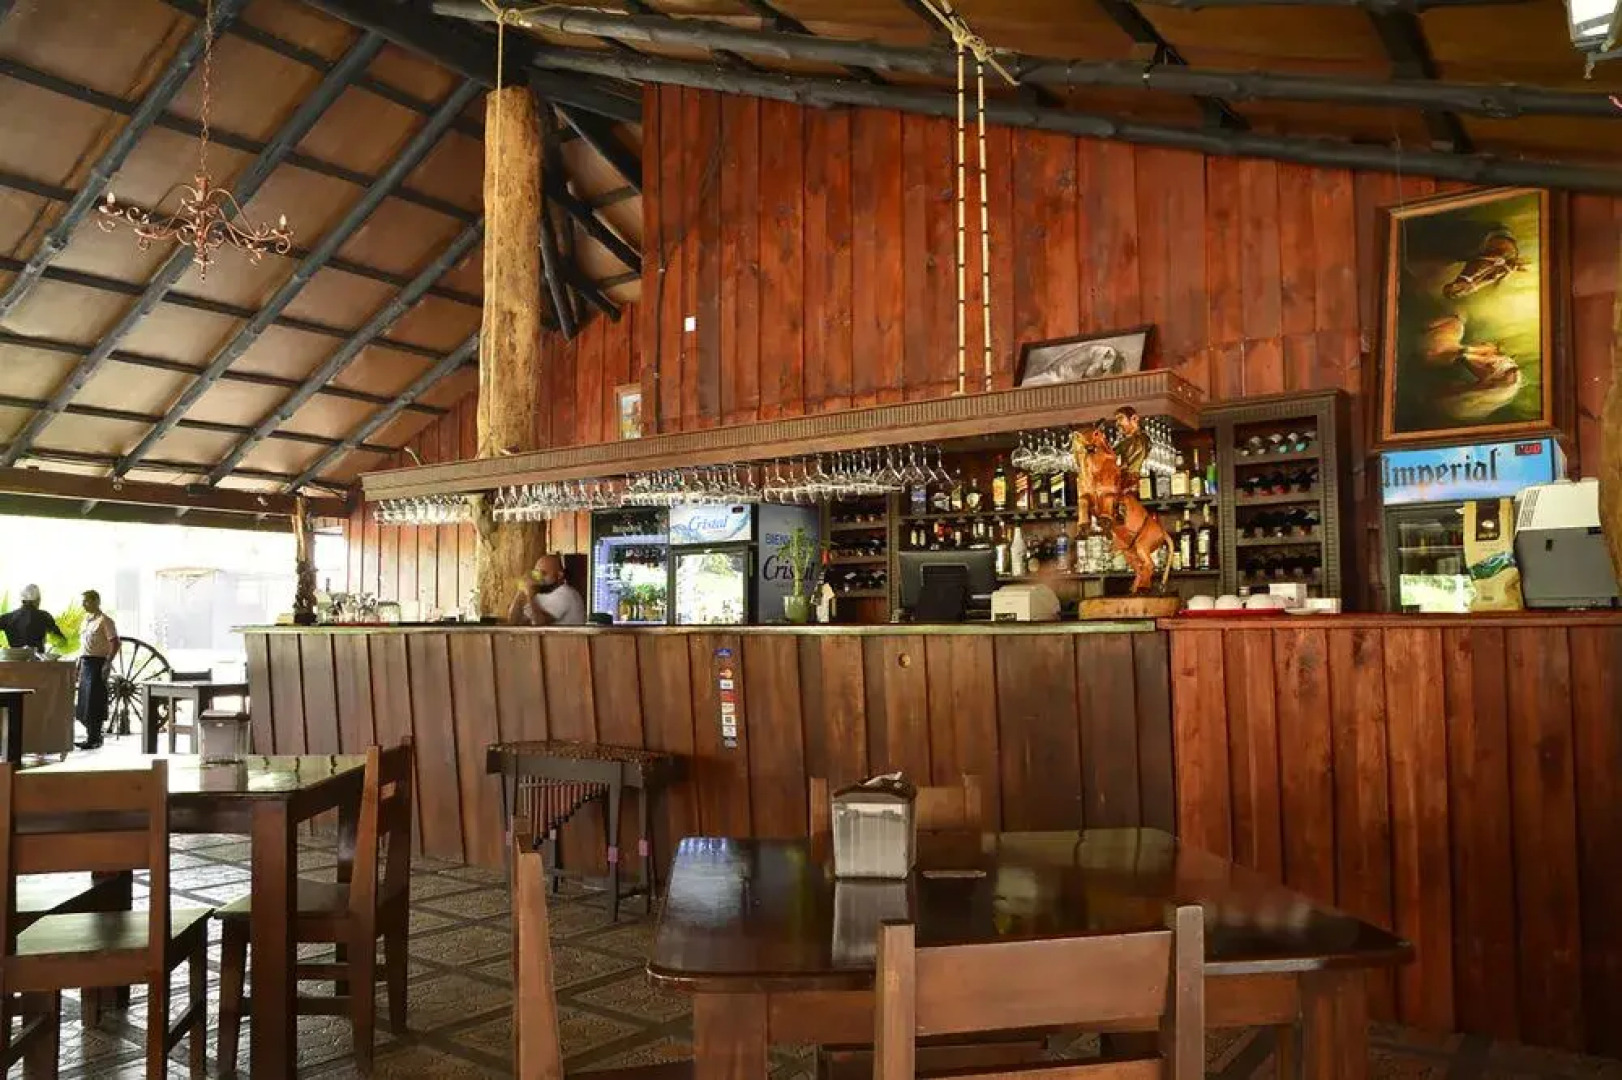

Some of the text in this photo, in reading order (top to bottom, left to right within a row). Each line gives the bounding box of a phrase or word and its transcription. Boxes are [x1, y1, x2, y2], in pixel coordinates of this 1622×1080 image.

[1383, 447, 1498, 488] Imperial
[688, 514, 729, 531] Cristal
[763, 555, 815, 581] Crisl
